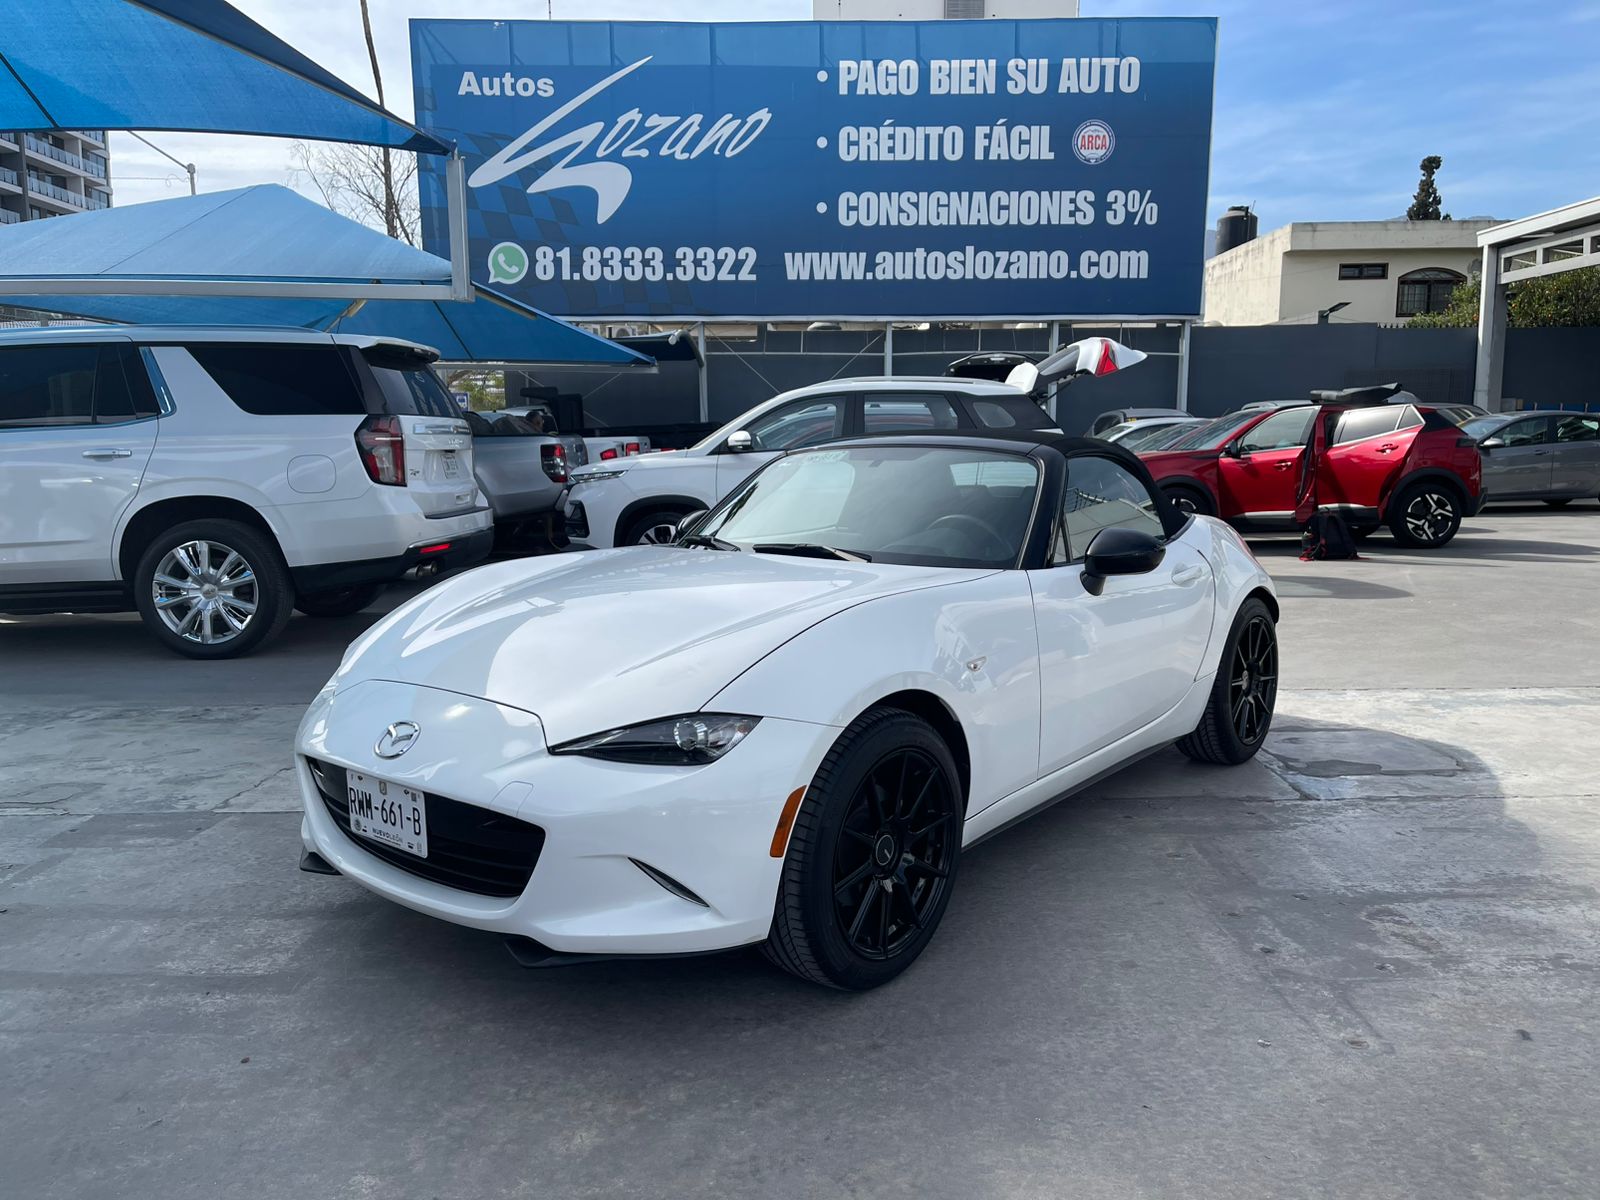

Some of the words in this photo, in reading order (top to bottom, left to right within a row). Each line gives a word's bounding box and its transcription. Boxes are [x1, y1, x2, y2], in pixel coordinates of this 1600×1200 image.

[458, 71, 555, 98] Autos
[838, 59, 919, 96] PAGO
[930, 59, 996, 95] BIEN
[1006, 58, 1048, 94] SU
[1058, 56, 1141, 94] AUTO
[467, 55, 772, 225] Lozano
[838, 119, 964, 162] CRÉDITO
[974, 118, 1055, 161] FÁCIL
[1080, 134, 1107, 150] ARCA
[838, 190, 1095, 226] CONSIGNACIONES
[1106, 189, 1159, 226] 3%
[535, 245, 757, 282] 81.8333.3322
[784, 245, 1149, 281] www.autoslozano.com
[349, 786, 421, 836] RWM-661-B
